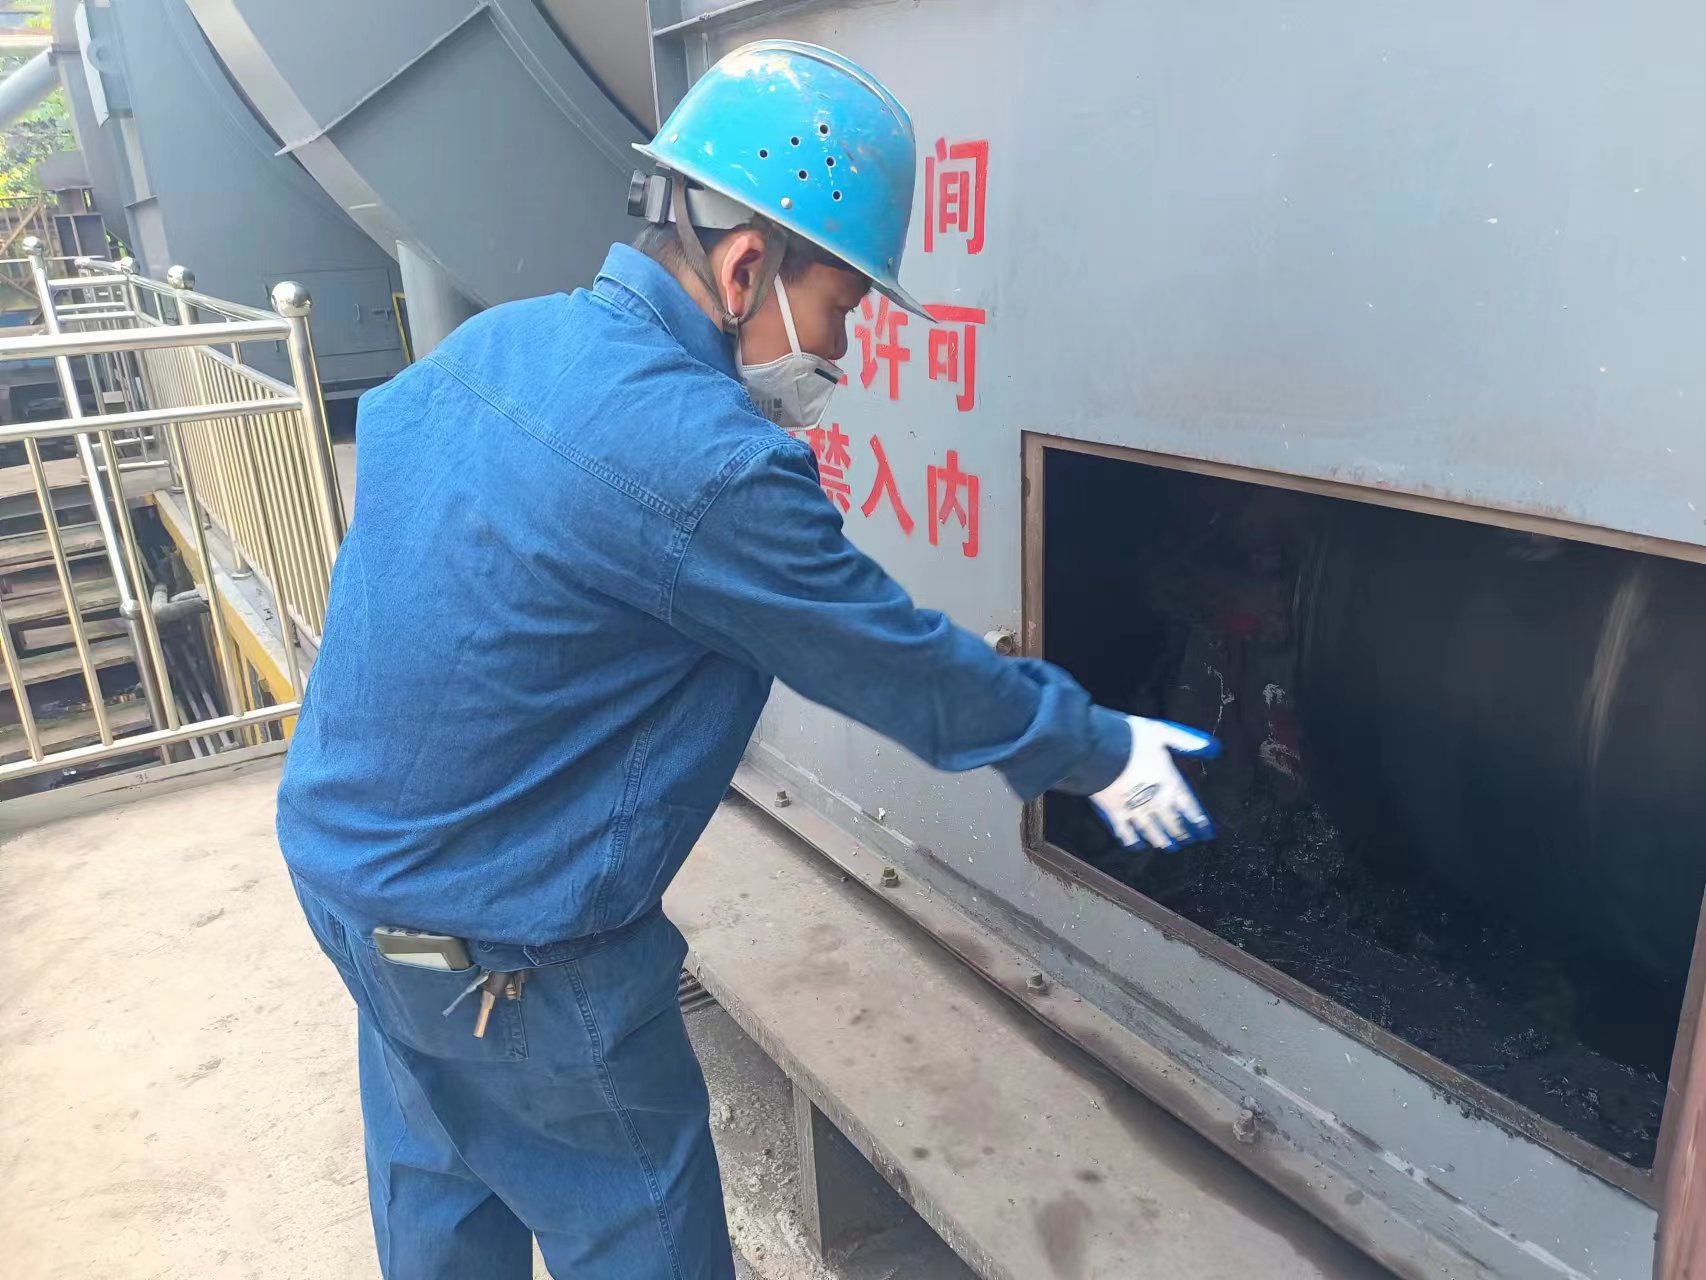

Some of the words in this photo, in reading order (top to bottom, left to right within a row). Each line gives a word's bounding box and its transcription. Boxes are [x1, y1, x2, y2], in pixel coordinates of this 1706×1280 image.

[923, 137, 990, 255] 间
[836, 296, 986, 412] 许可
[789, 424, 981, 558] 禁入内
